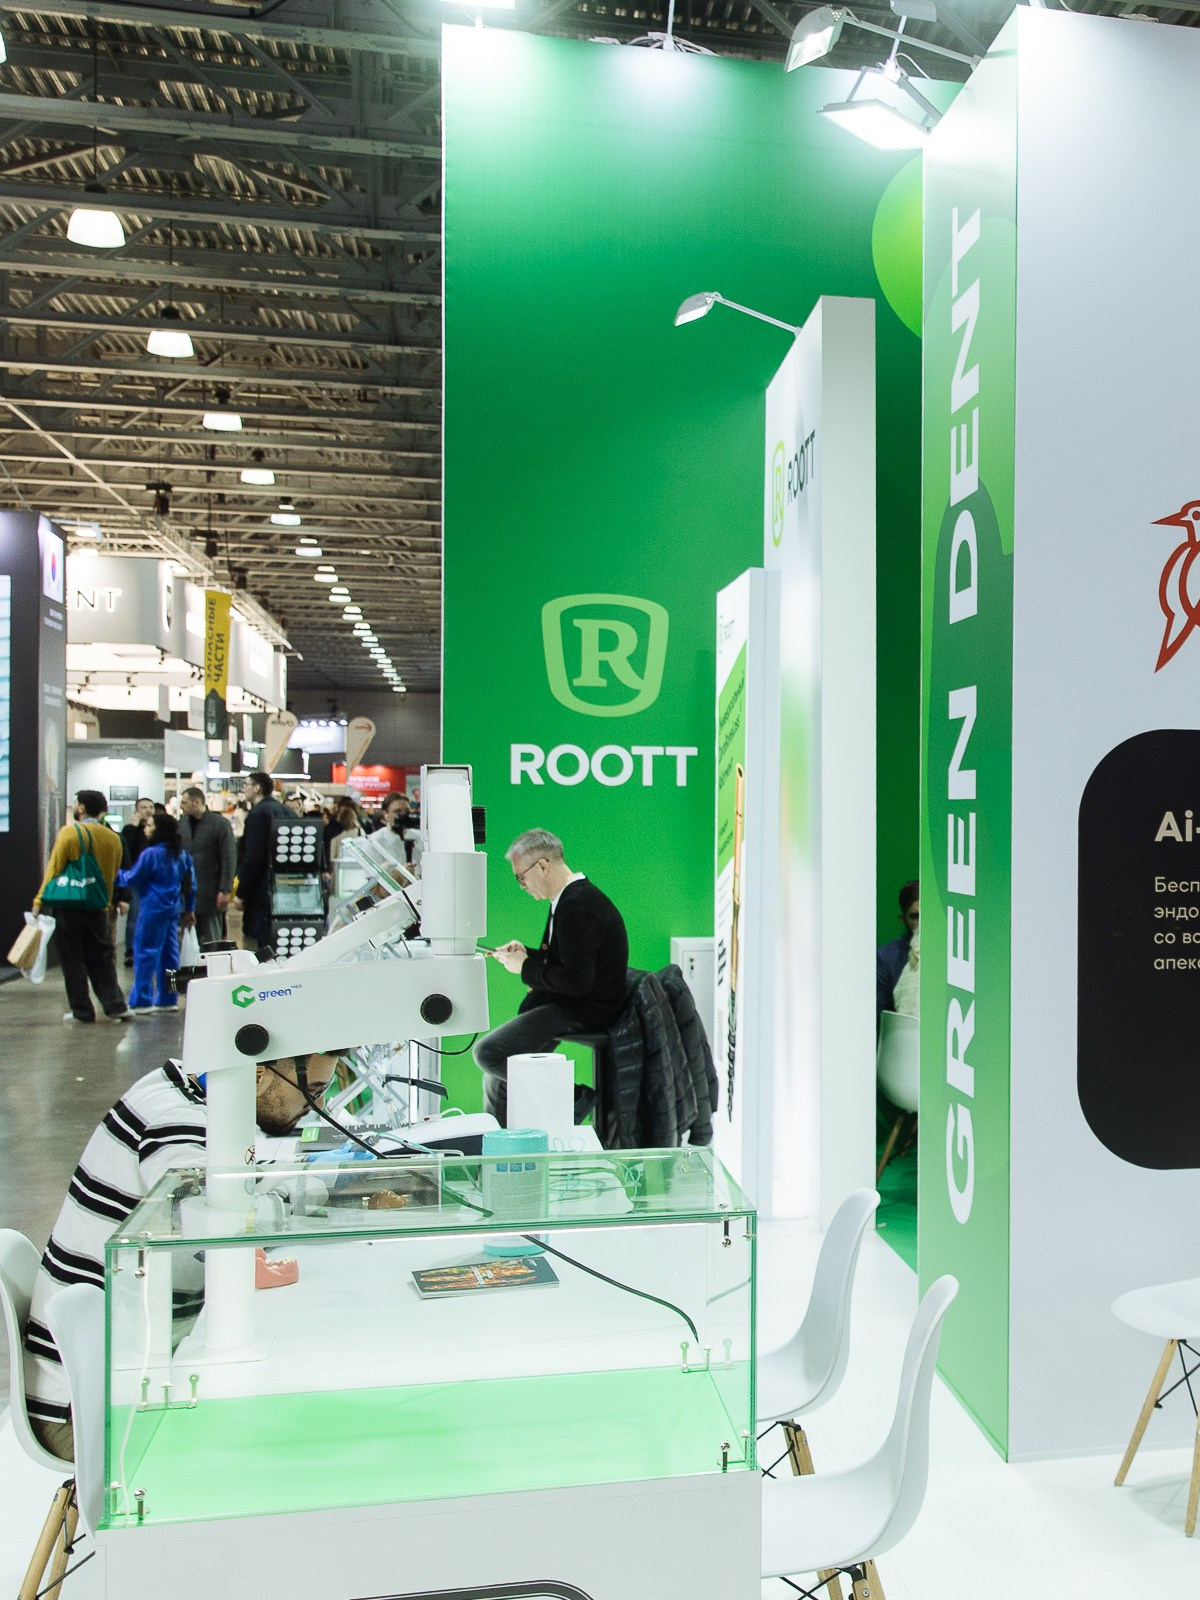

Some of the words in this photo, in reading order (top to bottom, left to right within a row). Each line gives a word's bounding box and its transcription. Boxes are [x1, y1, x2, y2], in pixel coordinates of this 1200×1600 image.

[948, 206, 981, 625] DENT
[787, 428, 816, 507] ROOTT
[66, 587, 122, 612] NT
[214, 633, 225, 683] ЧАСТИ
[510, 743, 699, 787] ROOTT
[945, 684, 978, 1225] GREEN
[1153, 932, 1176, 945] со
[258, 988, 292, 1001] green
